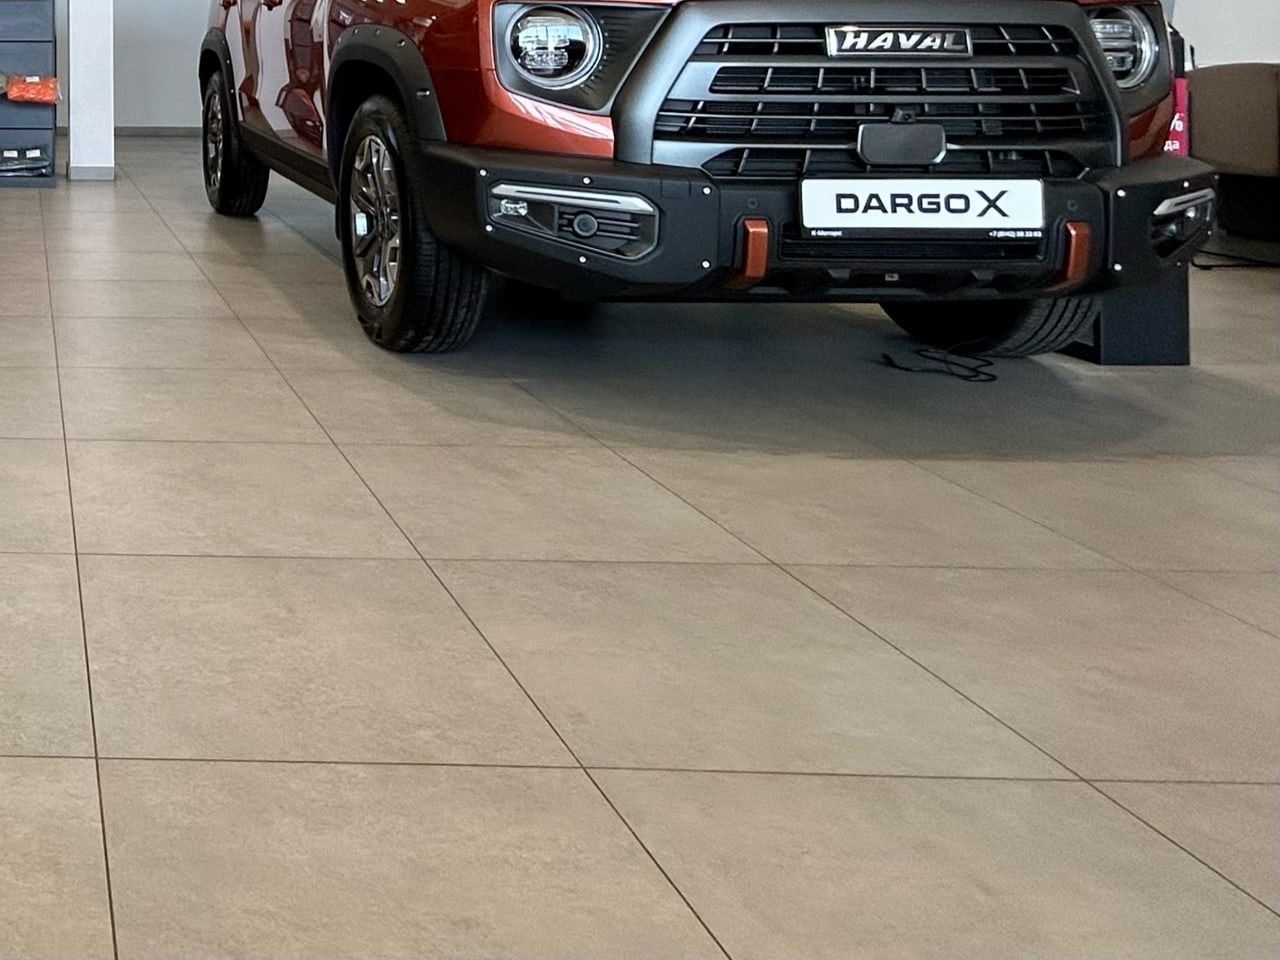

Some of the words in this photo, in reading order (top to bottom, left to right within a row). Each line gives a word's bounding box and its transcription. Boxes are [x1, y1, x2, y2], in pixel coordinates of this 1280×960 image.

[841, 32, 965, 50] HAVAL
[835, 193, 970, 214] DARGO
[975, 190, 1009, 217] X
